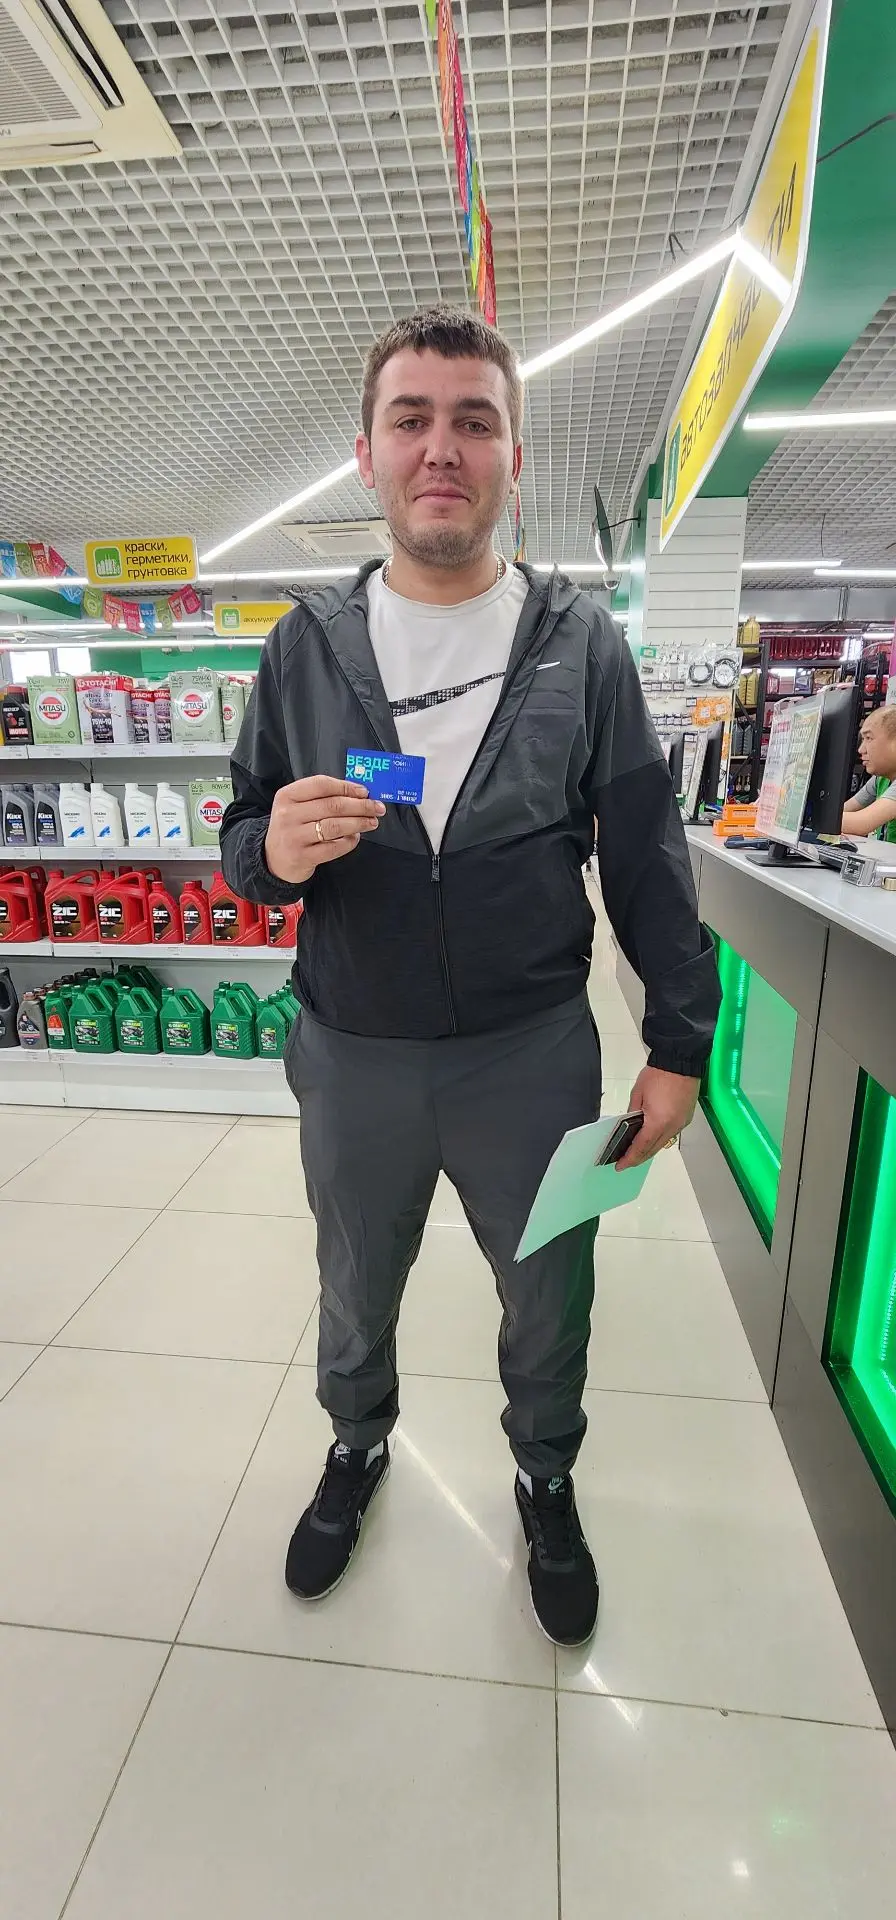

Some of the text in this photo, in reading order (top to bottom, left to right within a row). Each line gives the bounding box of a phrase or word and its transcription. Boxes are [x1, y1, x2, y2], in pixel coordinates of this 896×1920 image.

[124, 542, 168, 554] краски,
[126, 554, 192, 567] герметики,
[127, 567, 188, 580] грунтовка
[84, 679, 116, 687] TOTACHI
[38, 704, 67, 712] MITASU
[180, 702, 208, 710] MITASU
[346, 754, 390, 771] ВЕЗДЕ
[52, 906, 78, 916] ZIC
[98, 907, 122, 917] ZIC
[212, 909, 237, 919] ZIC
